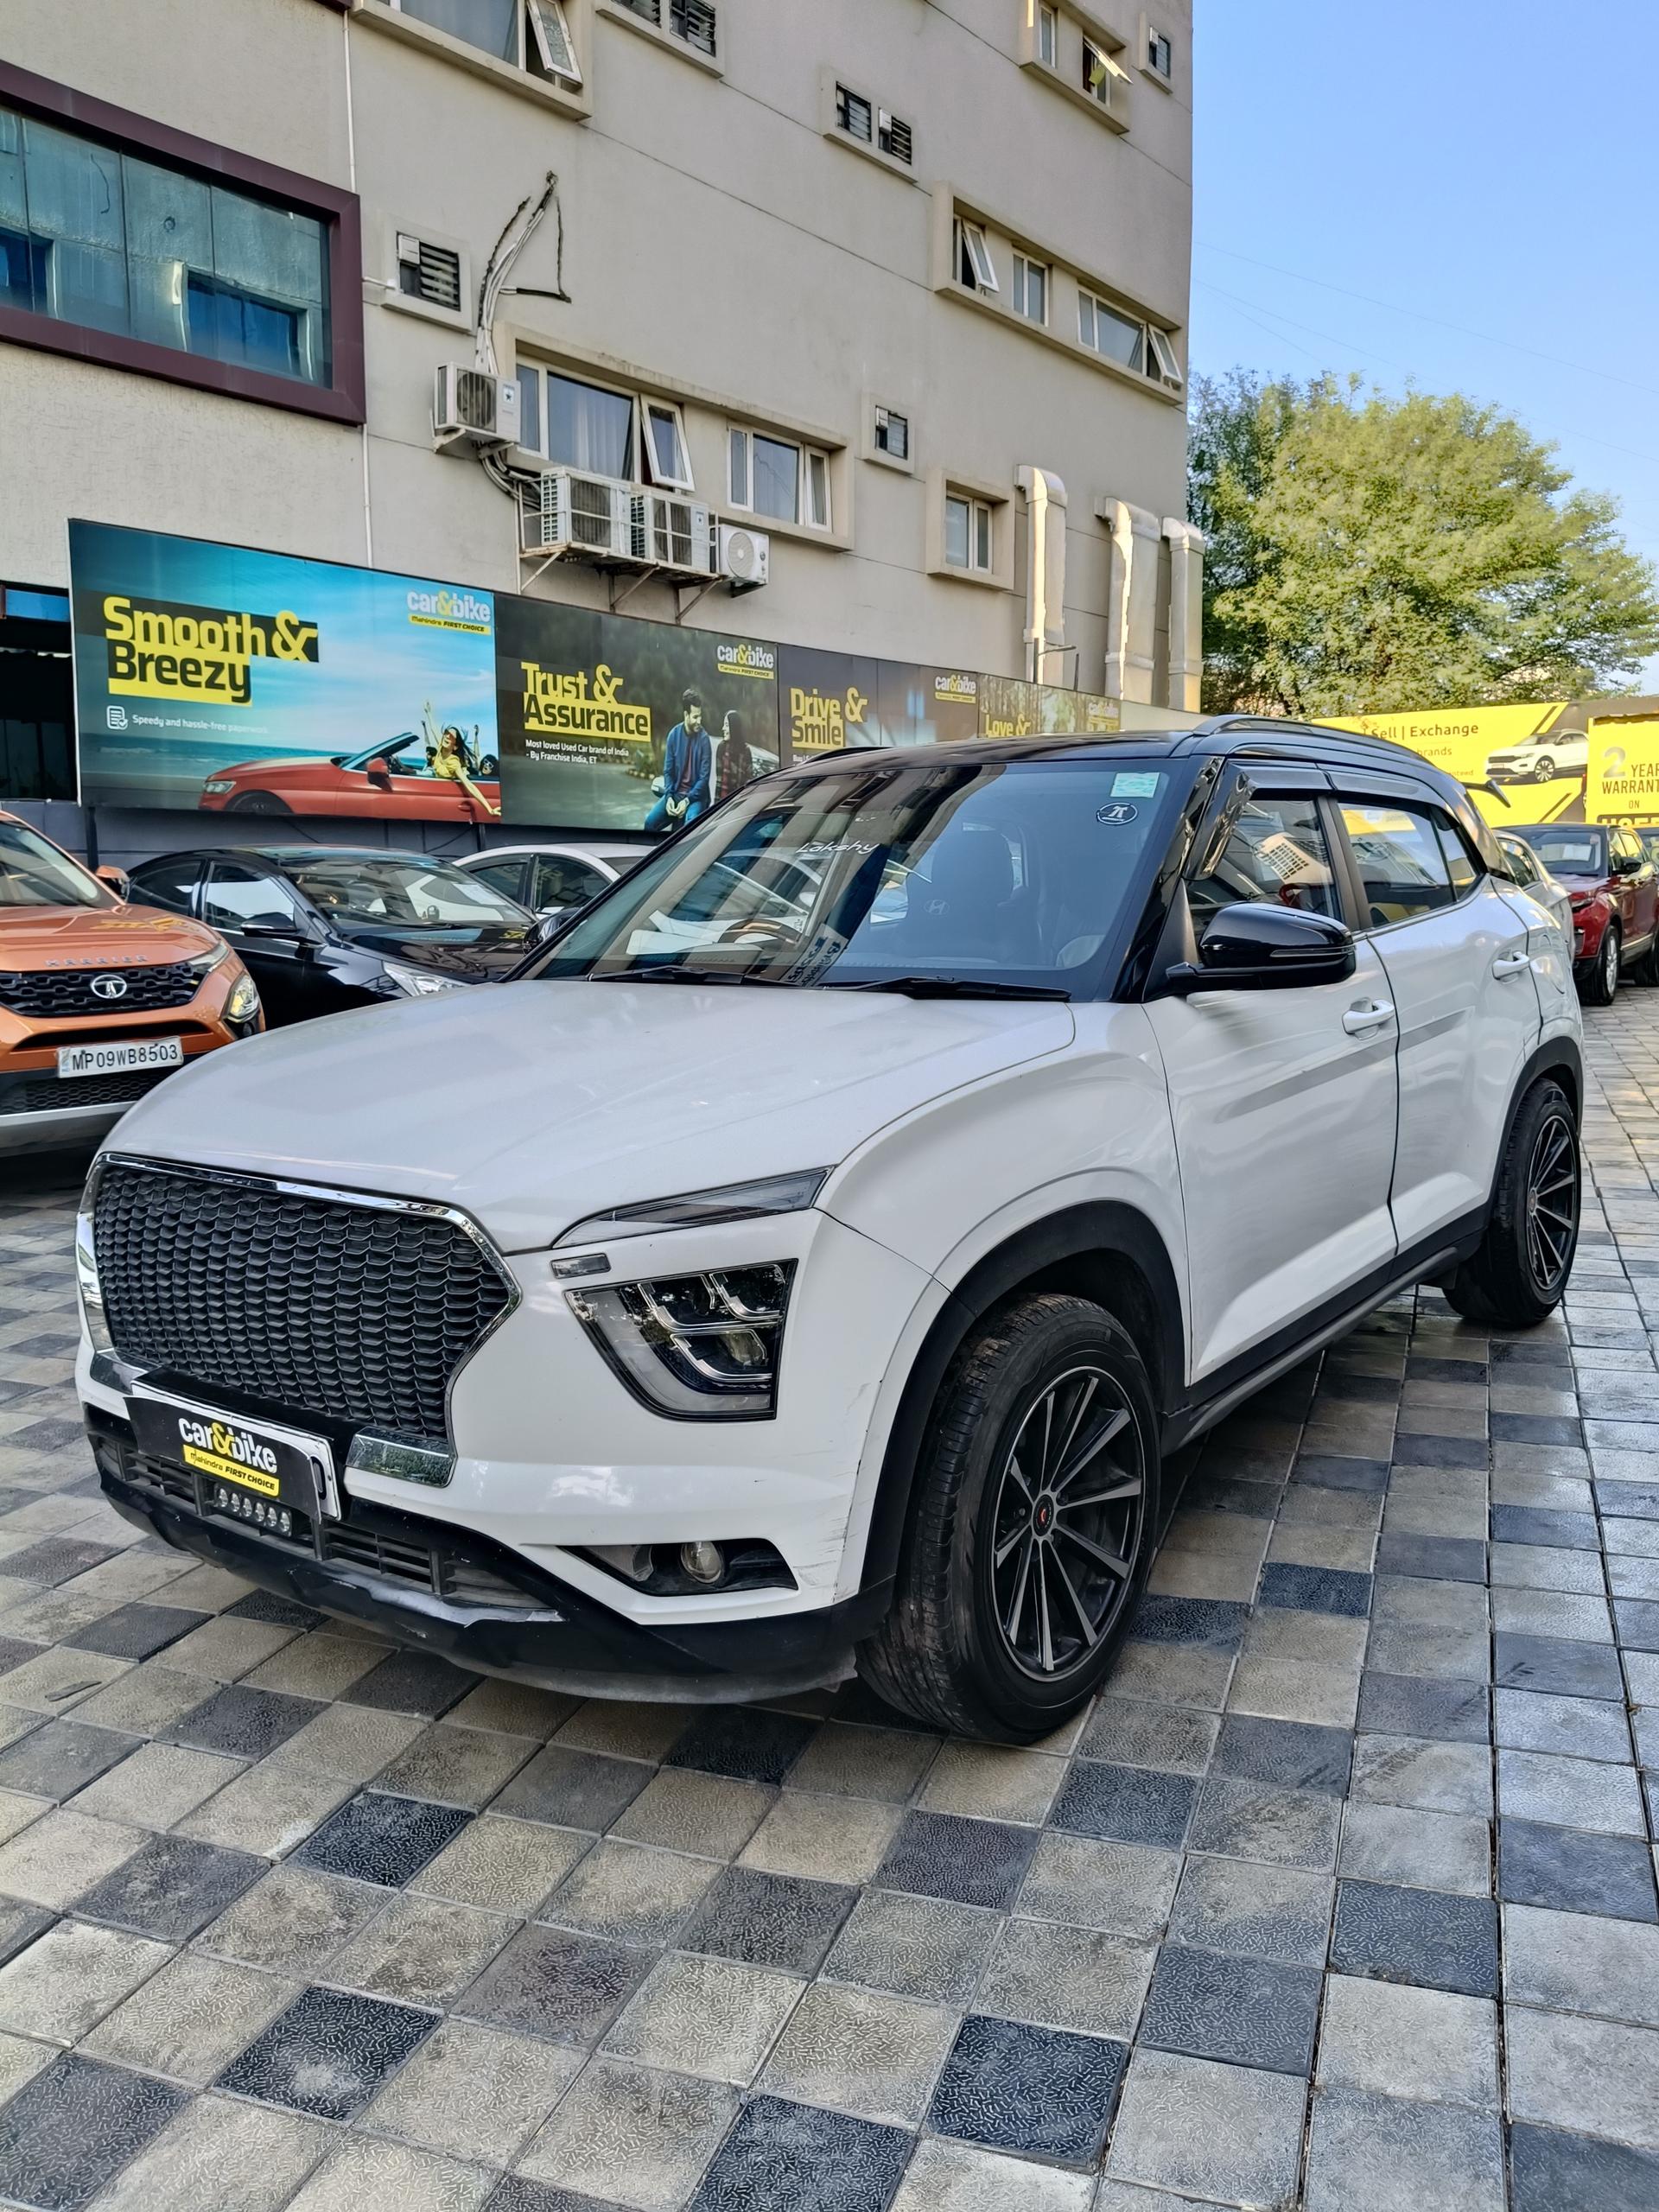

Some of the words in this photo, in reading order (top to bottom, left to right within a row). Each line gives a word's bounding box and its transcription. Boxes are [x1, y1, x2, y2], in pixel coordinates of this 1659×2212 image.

[407, 590, 491, 622] car&bike
[103, 596, 266, 657] Smooth
[271, 610, 319, 663] &
[462, 623, 485, 632] CHOICE
[717, 644, 774, 669] car&bike
[107, 639, 251, 703] Breezy
[521, 662, 588, 700] Trust
[594, 664, 624, 704] &
[524, 694, 649, 735] Assurance
[791, 688, 841, 719] Drive
[845, 687, 868, 723] &
[132, 715, 164, 728] Speedy
[165, 719, 181, 728] and
[182, 719, 226, 731] hassle-free
[791, 715, 842, 746] Smile
[986, 714, 1014, 736] Love
[1410, 724, 1479, 737] Exchange
[525, 739, 542, 748] Most
[543, 741, 560, 750] loved
[561, 743, 576, 752] Used
[589, 745, 606, 754] brand
[607, 747, 613, 755] of
[614, 748, 629, 757] India
[531, 751, 539, 760] By
[540, 752, 570, 762] Franchise
[589, 756, 597, 765] ET
[1604, 746, 1626, 779] 2
[1629, 800, 1640, 809] ON
[796, 840, 880, 855] Lakshy
[72, 1044, 178, 1071] MP09WB8503
[178, 1418, 277, 1473] car&bike
[225, 1465, 247, 1479] FIRST
[247, 1474, 276, 1491] CHOICE
